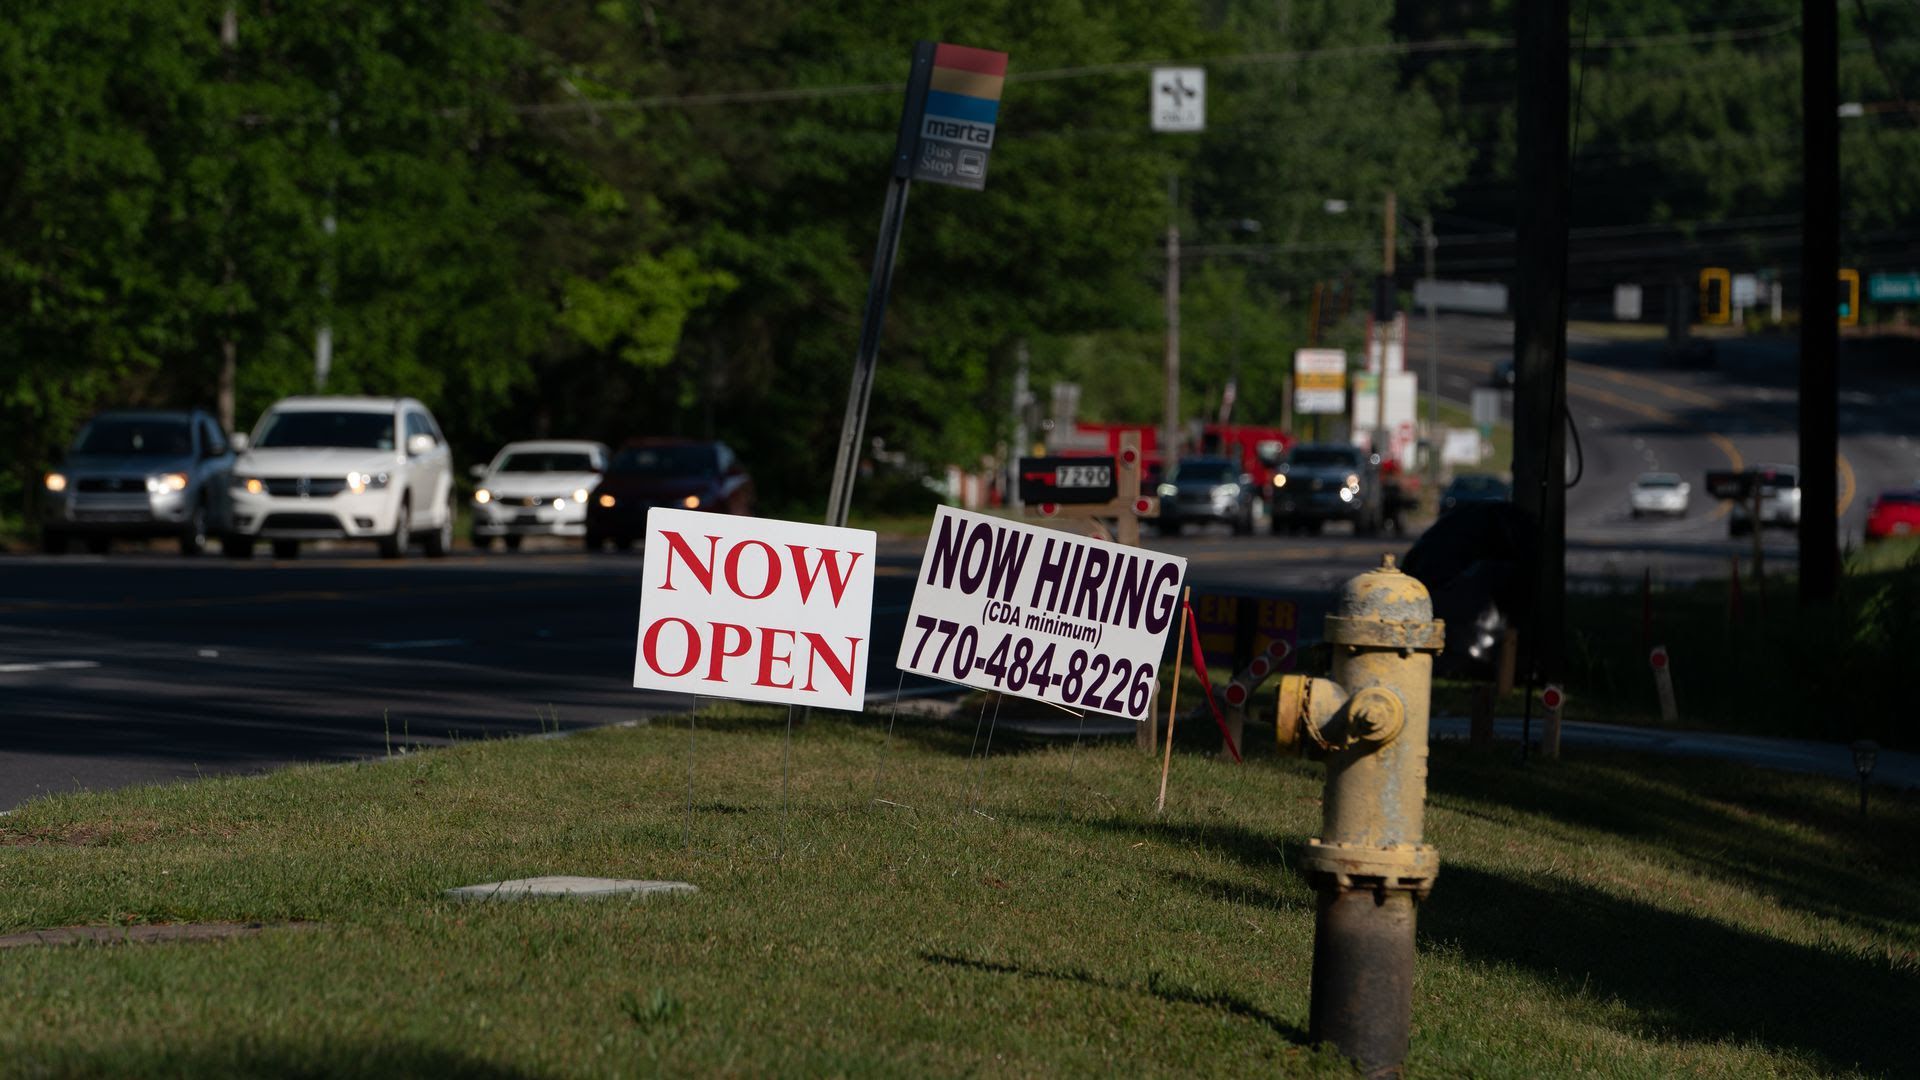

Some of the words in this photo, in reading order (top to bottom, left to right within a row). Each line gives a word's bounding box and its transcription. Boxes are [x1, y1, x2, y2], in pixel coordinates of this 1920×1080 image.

[924, 142, 953, 159] Bus
[926, 120, 990, 144] marta
[919, 156, 954, 177] Stop
[1059, 465, 1109, 487] 7290
[657, 530, 864, 609] NOW
[927, 515, 1034, 603] NOW
[1030, 538, 1179, 634] HIRING
[983, 600, 1020, 627] (CDA
[1025, 612, 1103, 650] minimum)
[1199, 595, 1294, 630] ENER
[643, 617, 864, 697] OPEN
[910, 615, 1154, 717] 770-484-8226
